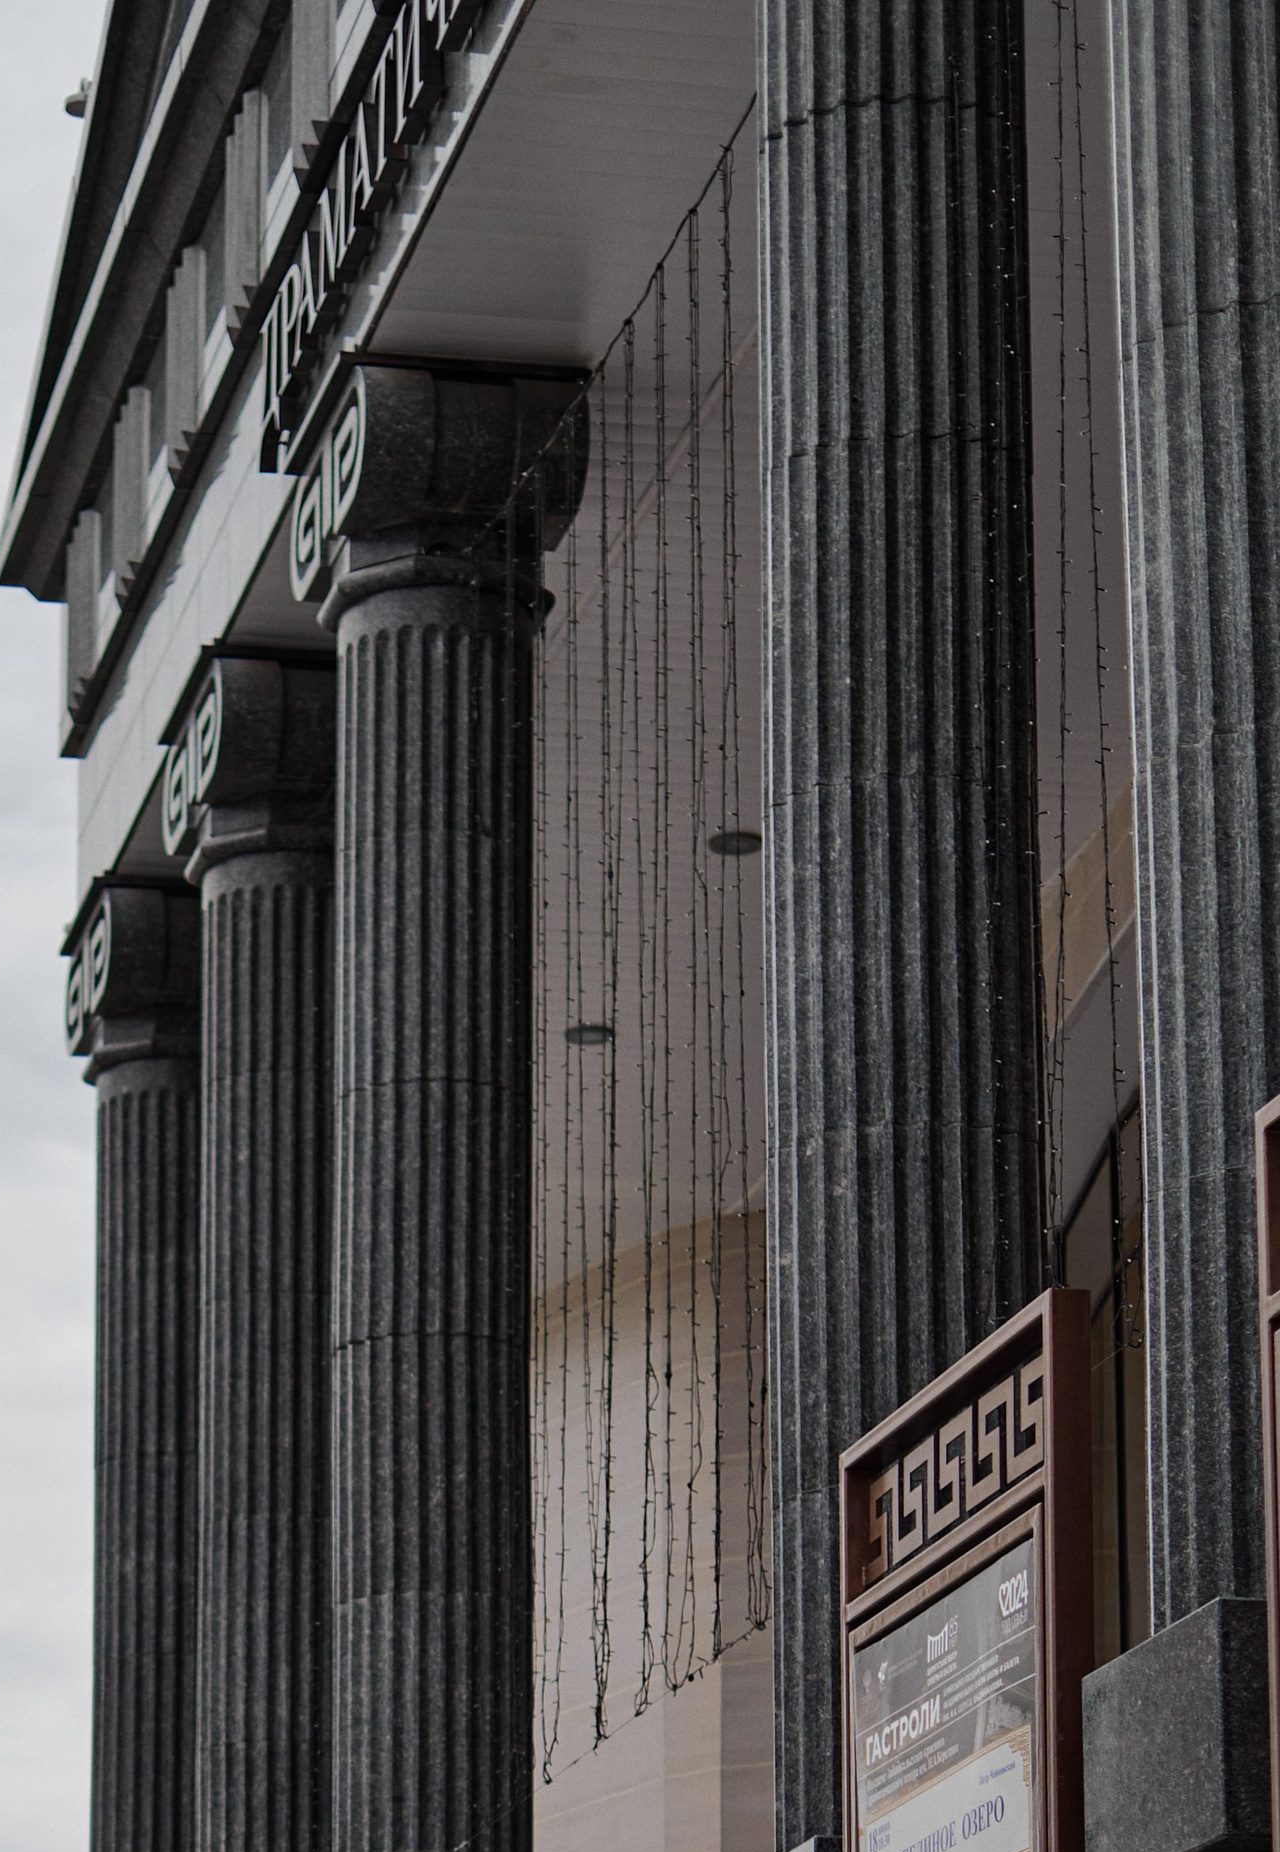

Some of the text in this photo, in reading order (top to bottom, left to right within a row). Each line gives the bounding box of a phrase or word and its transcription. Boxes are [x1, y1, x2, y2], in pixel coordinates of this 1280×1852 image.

[1000, 1570, 1029, 1617] 2024
[949, 1615, 958, 1637] 85
[866, 1694, 940, 1766] ГАСТРОЛИ
[990, 1760, 1016, 1778] Чайковский
[962, 1795, 1005, 1840] ОЗЕРО
